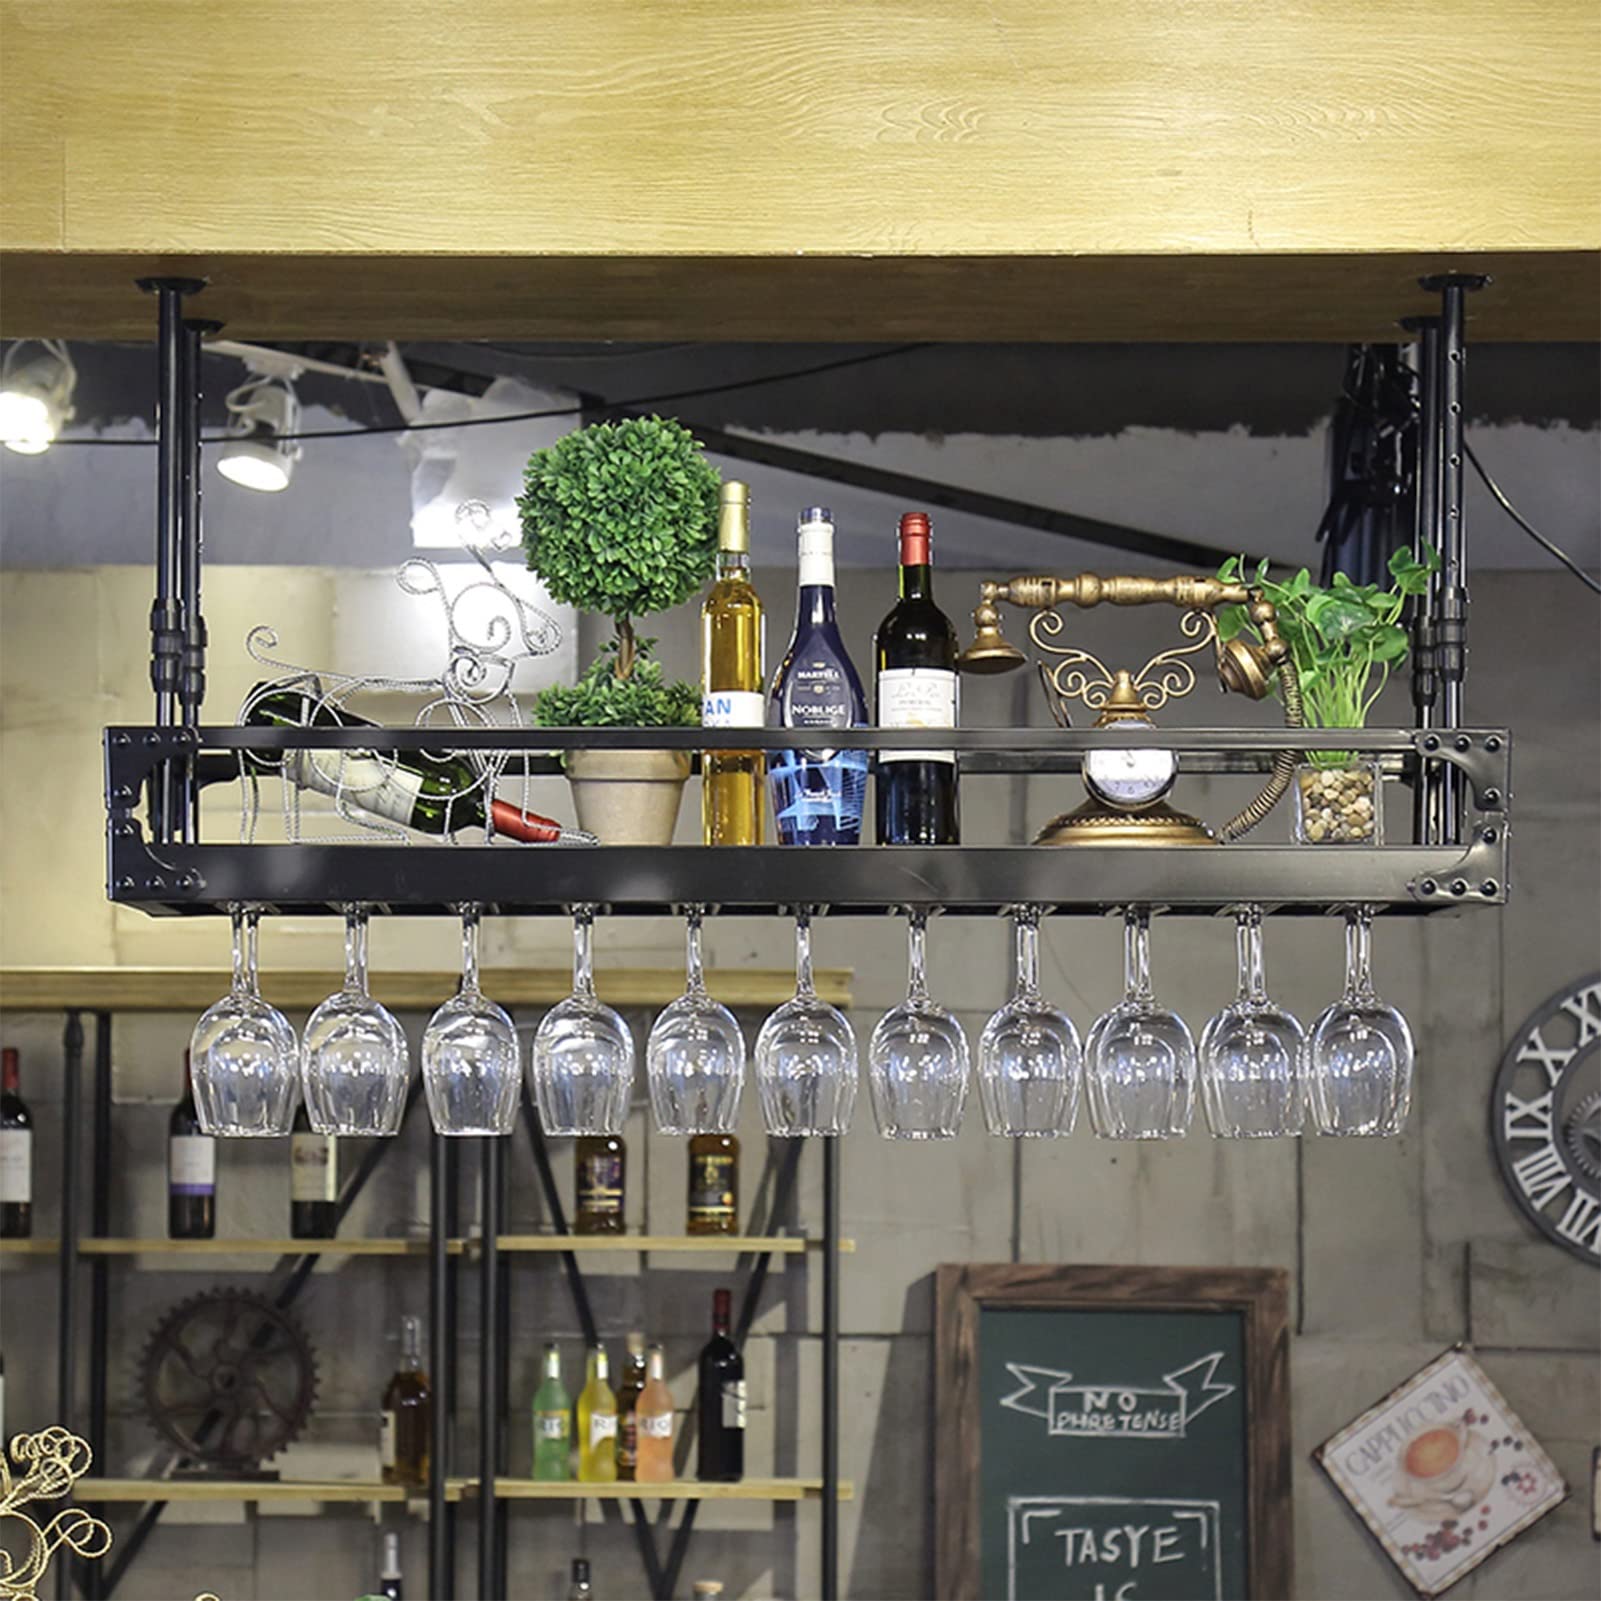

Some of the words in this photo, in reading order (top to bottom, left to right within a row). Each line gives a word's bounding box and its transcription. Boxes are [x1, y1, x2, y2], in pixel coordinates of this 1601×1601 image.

[1516, 1026, 1577, 1087] X
[1083, 1391, 1137, 1413] NO
[1344, 1374, 1470, 1477] CAPPUCCINO
[1055, 1524, 1186, 1568] TASYE
